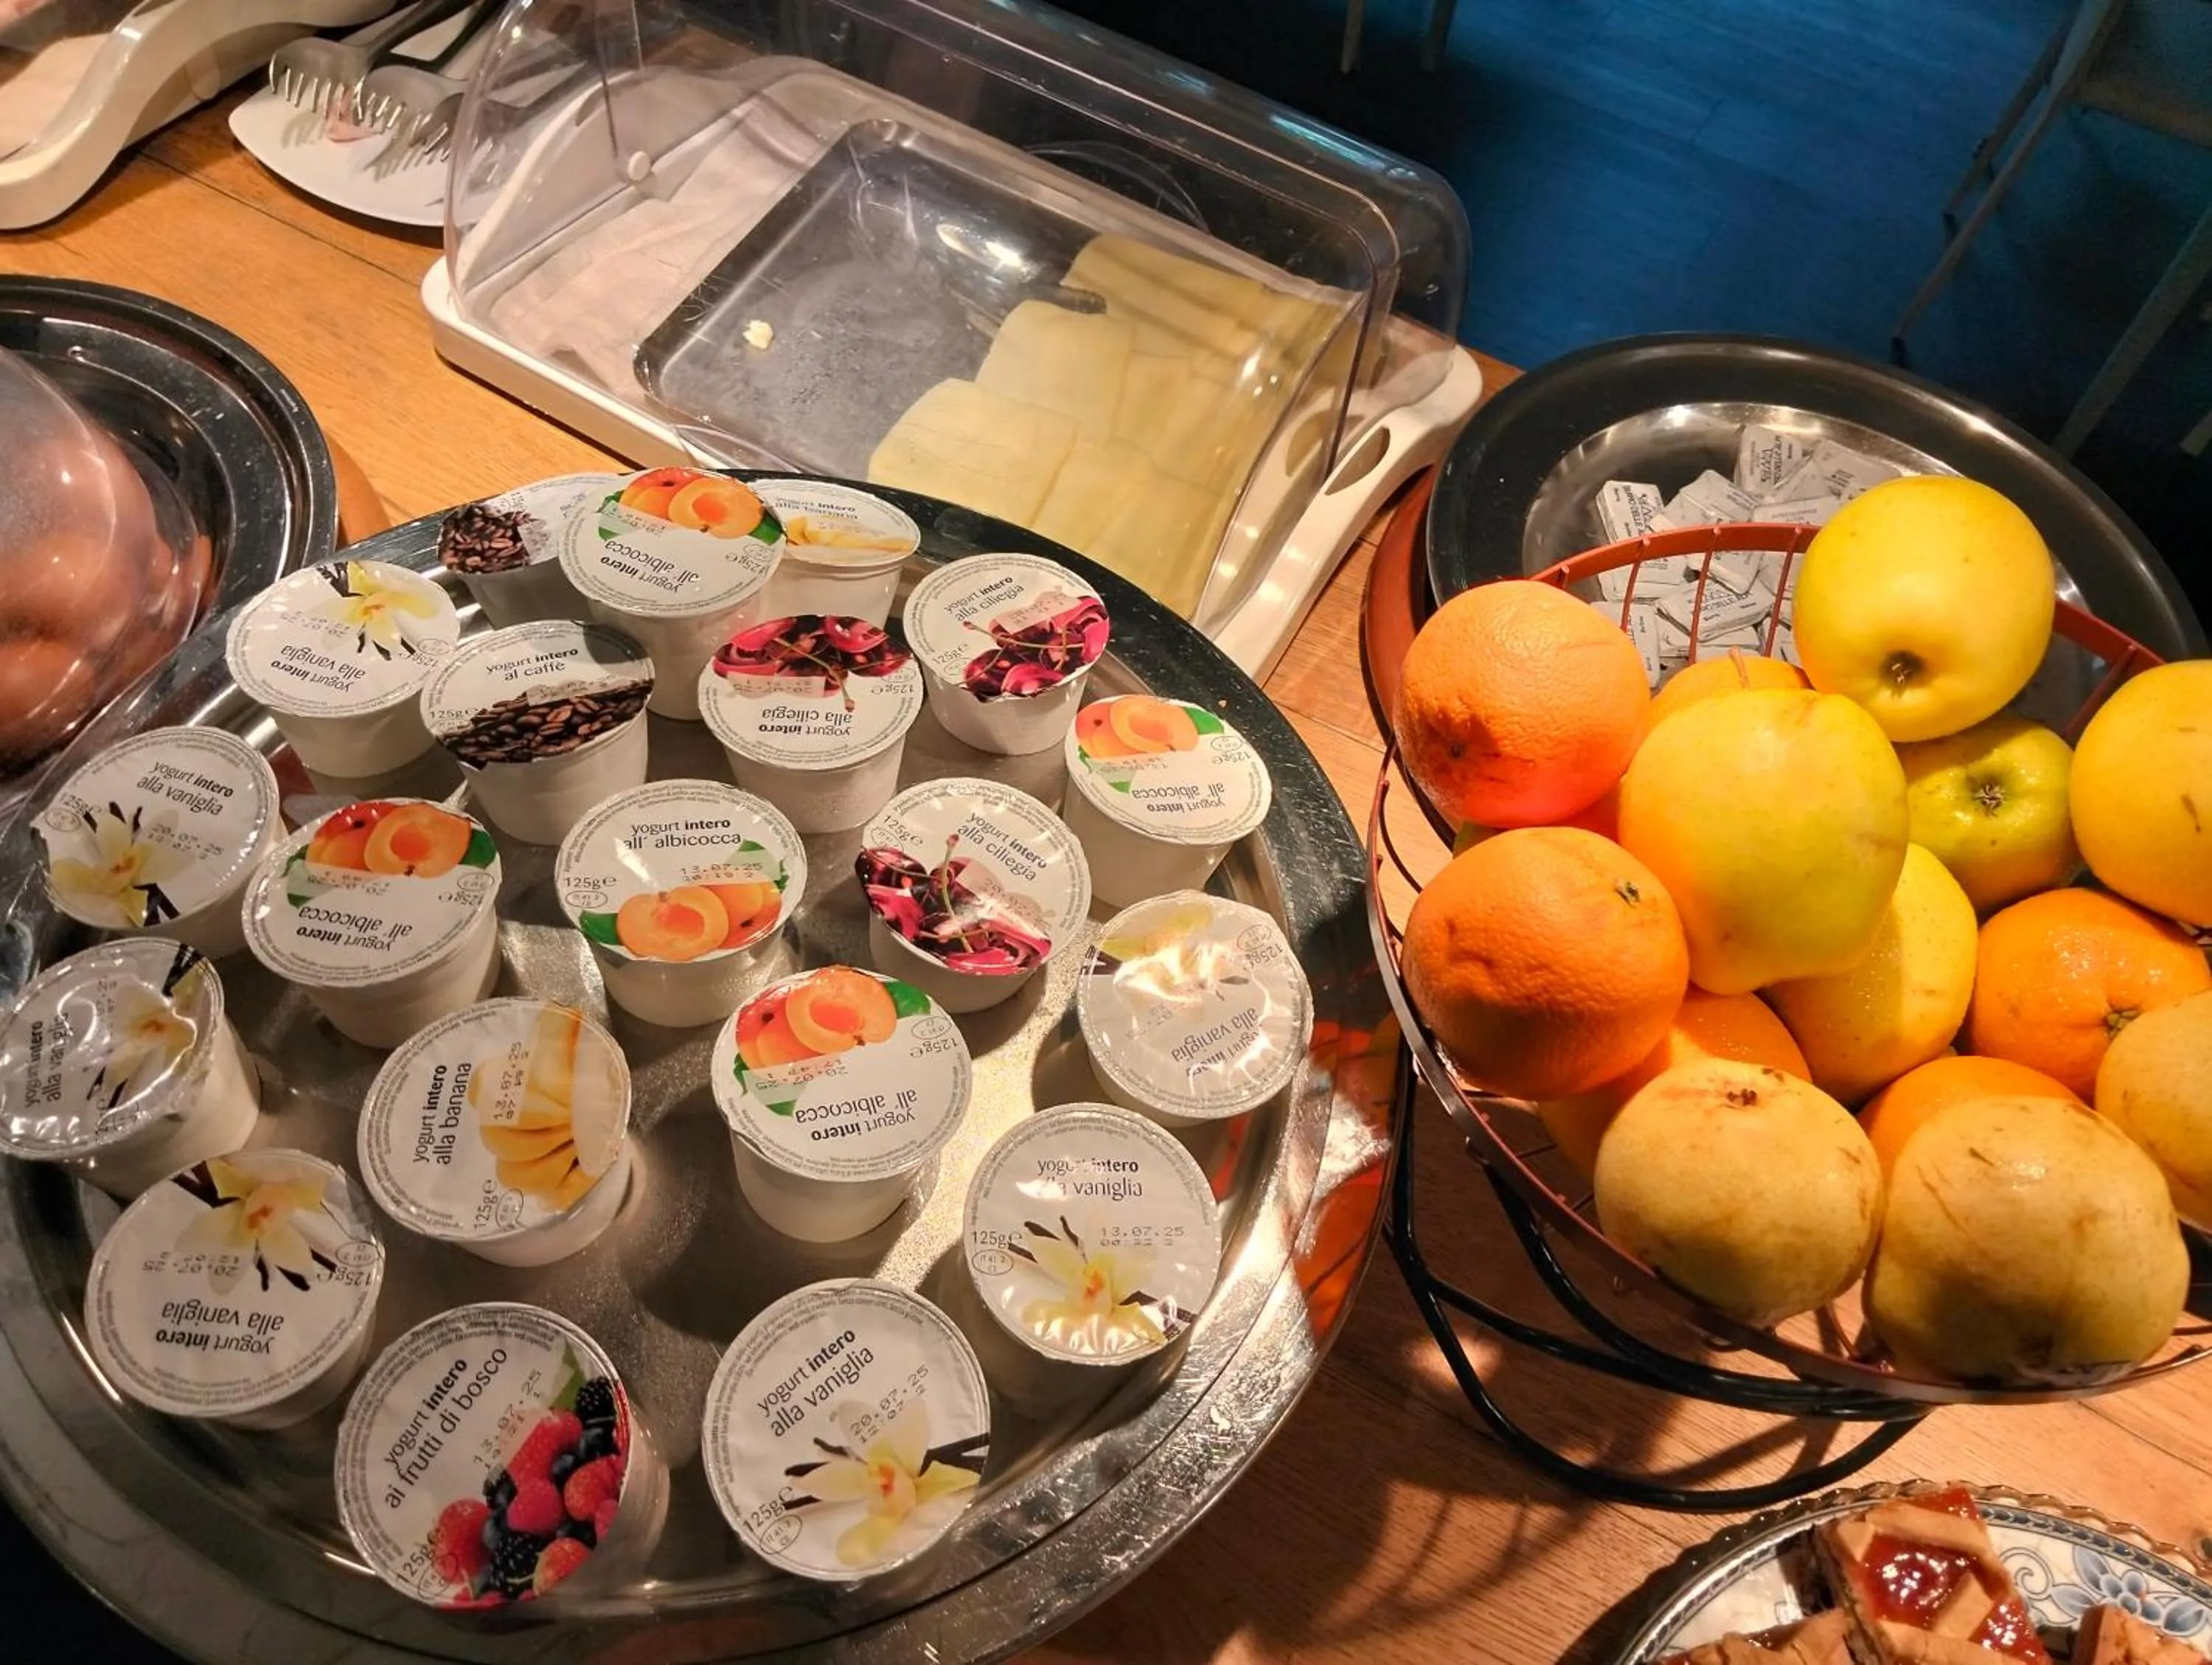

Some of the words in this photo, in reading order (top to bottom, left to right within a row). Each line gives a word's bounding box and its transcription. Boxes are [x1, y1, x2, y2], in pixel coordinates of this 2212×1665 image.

[818, 503, 855, 511] intero
[601, 556, 638, 576] intero
[605, 540, 675, 572] albicocca
[638, 570, 683, 593] yogurt
[944, 588, 980, 613] yogurt
[981, 577, 1014, 596] intero
[956, 605, 980, 622] alla
[981, 585, 1024, 611] ciliegia
[281, 644, 335, 671] vaniglia
[485, 657, 532, 674] yogurt
[535, 647, 578, 664] intero
[271, 660, 310, 681] intero
[338, 664, 366, 680] alla
[504, 670, 518, 681] al
[310, 673, 354, 694] yogurt
[762, 706, 820, 723] ciliegia
[824, 712, 852, 726] alla
[759, 724, 801, 734] intero
[807, 725, 854, 736] yogurt
[150, 761, 194, 782] yogurt
[193, 776, 234, 797] intero
[137, 776, 163, 793] alla
[165, 785, 224, 816] vaniglia
[1132, 784, 1201, 800] albicocca
[1147, 801, 1184, 813] intero
[1186, 797, 1225, 813] yogurt
[631, 821, 681, 836] yogurt
[684, 819, 731, 830] intero
[654, 833, 741, 848] albicocca
[959, 823, 984, 845] alla
[985, 841, 1037, 881] ciliegia
[968, 812, 1009, 842] yogurt
[1009, 838, 1047, 869] intero
[681, 863, 762, 875] 13.07.25
[299, 906, 383, 934] albicocca
[296, 926, 343, 943] intero
[344, 935, 392, 951] yogurt
[1231, 1008, 1258, 1029] alla
[31, 1021, 44, 1063] intero
[1172, 1025, 1231, 1062] vaniglia
[1227, 1032, 1259, 1057] ogurt
[25, 1063, 43, 1108] yogur
[41, 1074, 60, 1103] alla
[423, 1065, 447, 1110] intero
[756, 1066, 846, 1090] 20.07.25
[442, 1063, 472, 1130] banana
[894, 1090, 918, 1110] all'
[796, 1095, 886, 1124] albicocca
[863, 1108, 916, 1133] yogurt
[413, 1108, 435, 1164] yogurt
[811, 1123, 862, 1141] intero
[430, 1125, 456, 1165] alla
[1037, 1159, 1085, 1176] yogu
[1091, 1157, 1138, 1172] intero
[1073, 1178, 1142, 1201] vaniglia
[1100, 1227, 1185, 1238] 13.07.25
[161, 1299, 240, 1327] vaniglia
[247, 1313, 284, 1336] alla
[156, 1329, 211, 1352] intero
[213, 1335, 275, 1354] yogurt
[757, 1366, 810, 1417] yogurt
[809, 1329, 856, 1372] intero
[770, 1405, 804, 1437] alla
[803, 1346, 874, 1408] vaniglia
[849, 1364, 928, 1436] 20.07.25
[383, 1410, 430, 1468] yogurt
[423, 1359, 468, 1411] intero
[474, 1369, 542, 1464] 13.07.25
[385, 1484, 406, 1509] ai
[398, 1433, 445, 1487] frutti
[441, 1409, 461, 1433] di
[459, 1348, 507, 1410] bosco
